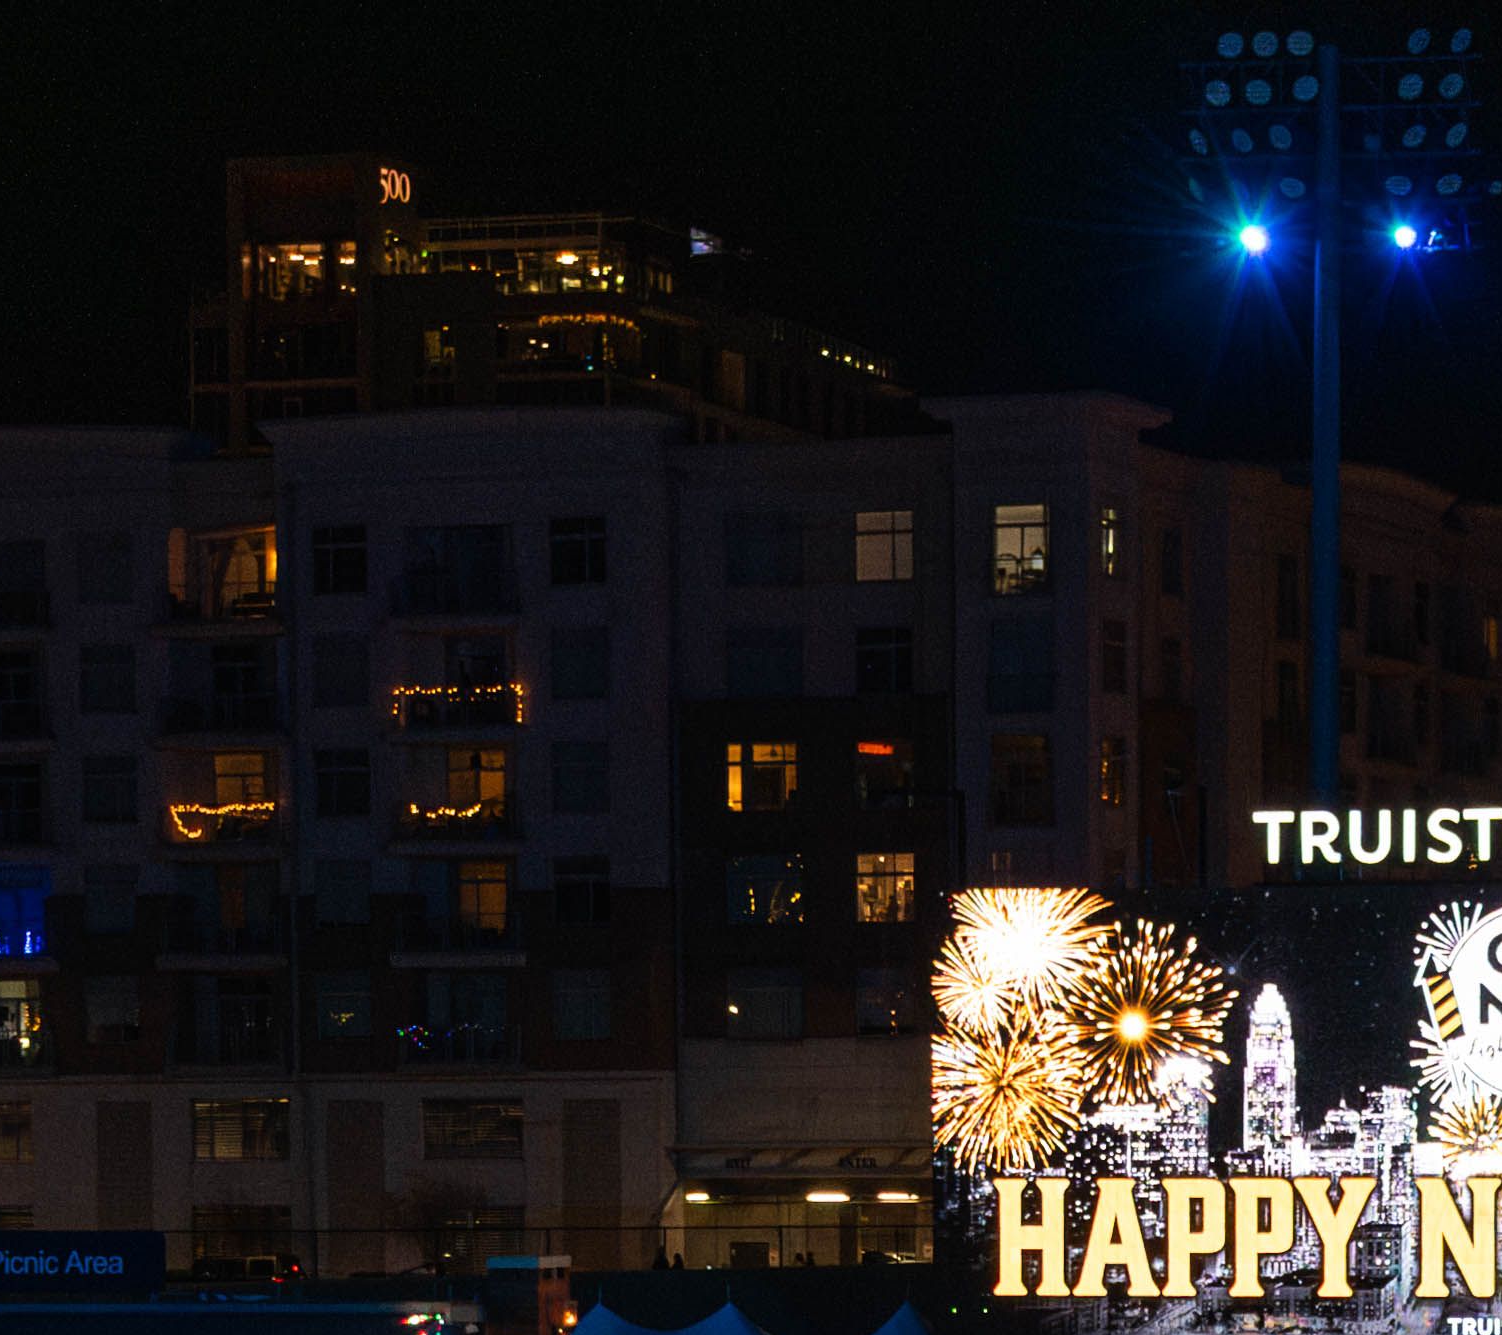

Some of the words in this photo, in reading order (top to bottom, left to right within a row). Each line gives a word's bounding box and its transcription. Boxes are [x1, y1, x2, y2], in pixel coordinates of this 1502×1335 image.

[379, 167, 410, 204] 500
[993, 1176, 1377, 1298] HAPPY
[64, 1249, 125, 1276] Area
